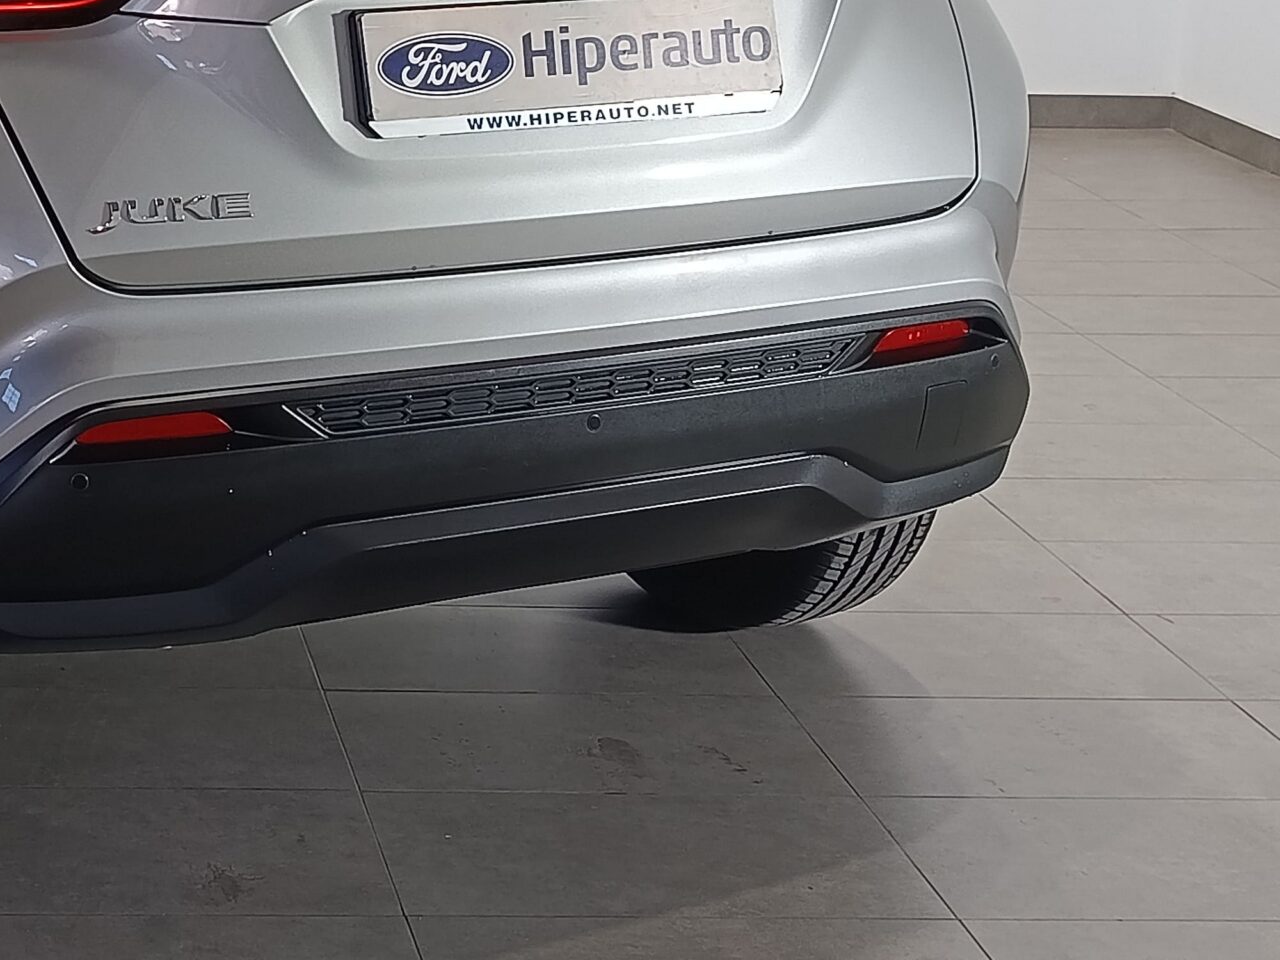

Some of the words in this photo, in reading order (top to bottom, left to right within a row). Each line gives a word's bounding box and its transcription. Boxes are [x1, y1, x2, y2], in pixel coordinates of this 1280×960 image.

[402, 42, 492, 86] Ford
[522, 18, 772, 85] Hiperauto
[467, 102, 696, 130] WWW.HIPERAUTO.NET
[86, 193, 254, 234] JUKE
